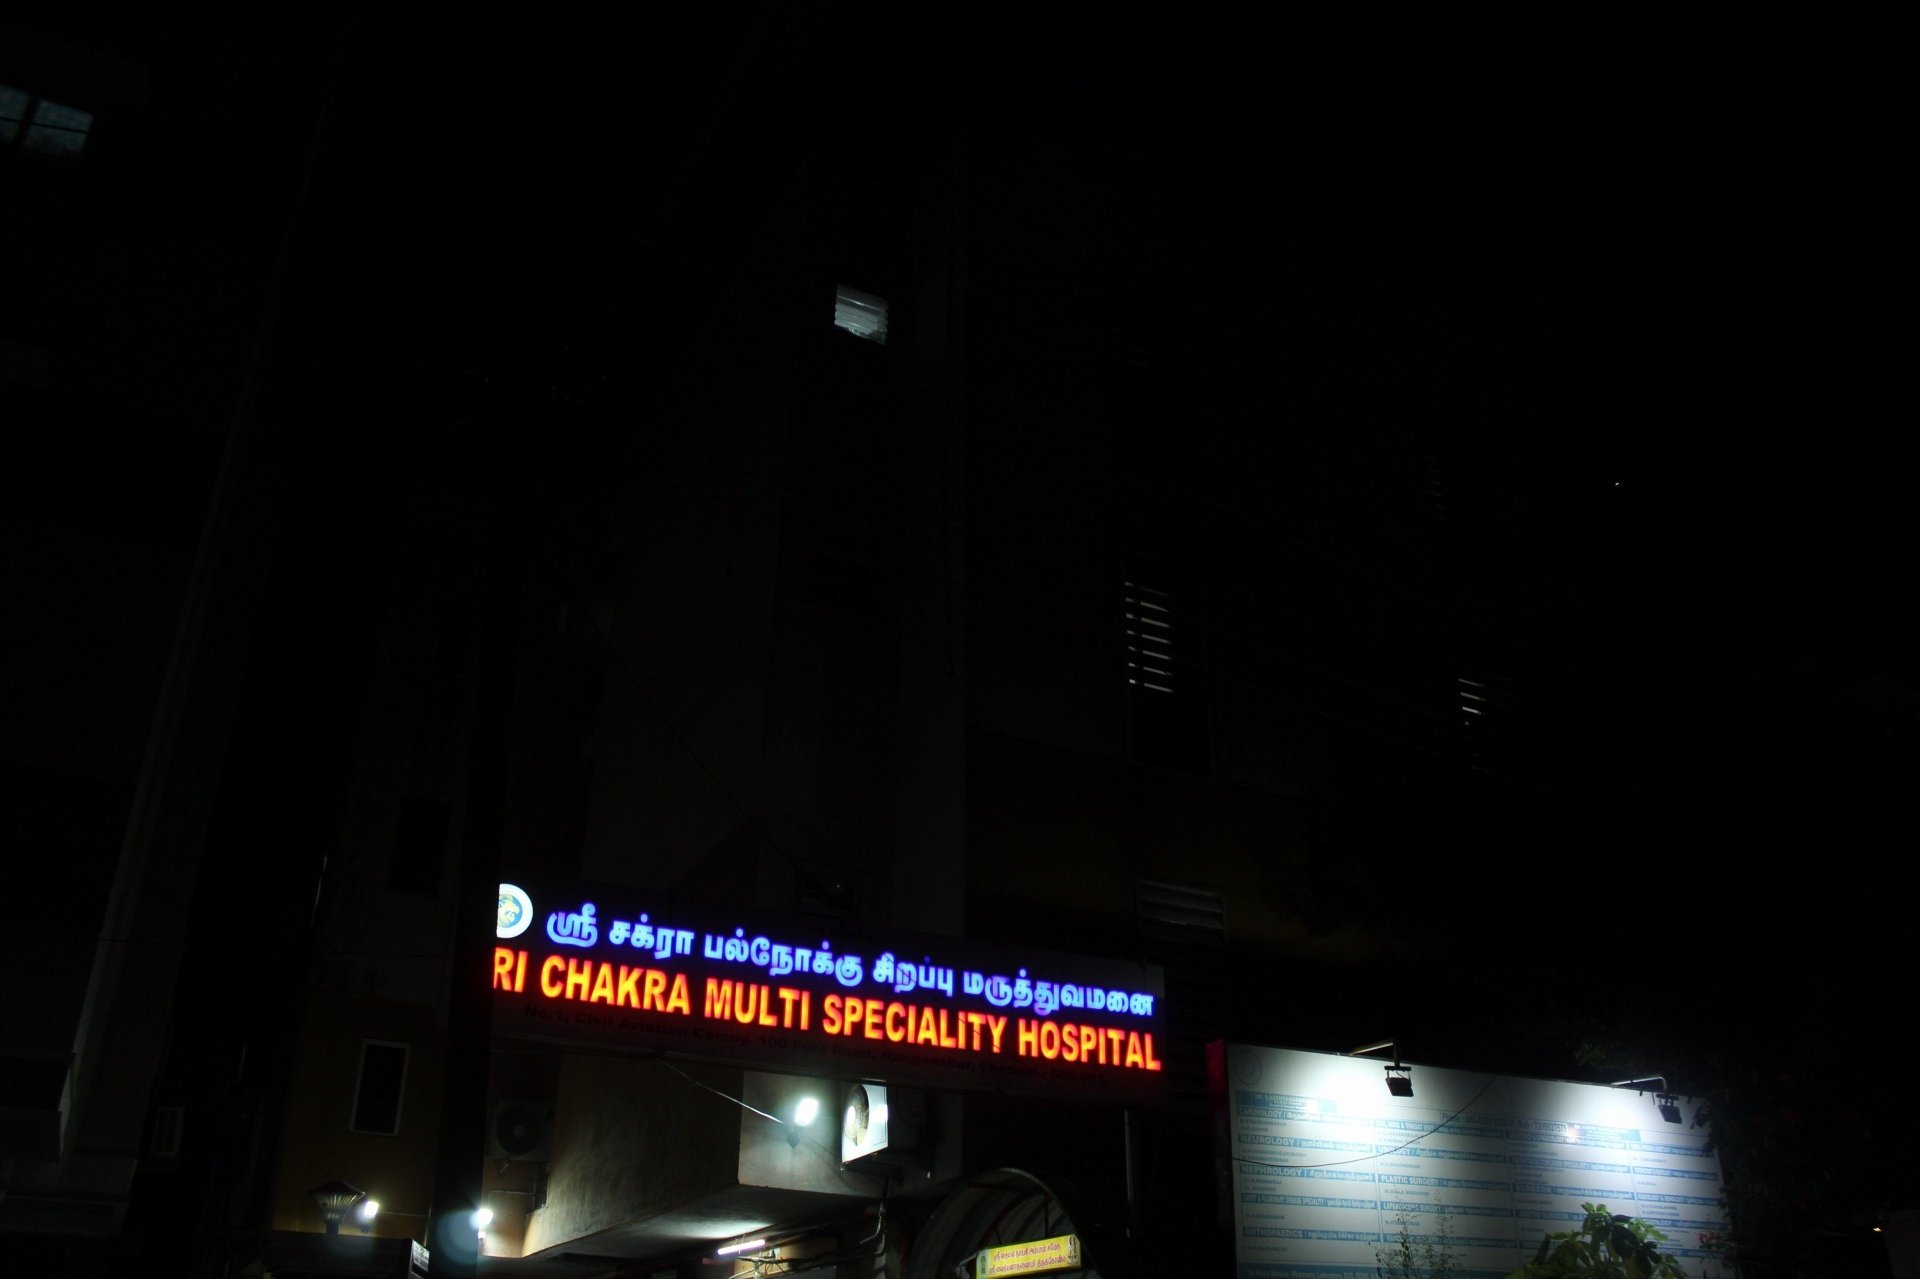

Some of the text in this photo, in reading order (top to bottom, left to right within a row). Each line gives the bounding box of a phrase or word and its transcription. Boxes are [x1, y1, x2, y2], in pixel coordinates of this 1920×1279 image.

[547, 902, 1154, 1016] ஸ்ரீ சக்ரா பல்நோக்கு சிறப்பு மருத்துவமனை
[540, 955, 691, 1016] CHAKRA
[703, 977, 811, 1031] MULTI
[822, 993, 1008, 1054] SPECIALITY
[1018, 1017, 1162, 1071] HOSPITAL
[1240, 1133, 1294, 1147] NEUROLOGY
[1241, 1165, 1302, 1178] NEPHROLOGY
[1380, 1175, 1408, 1185] PLASTIC
[1409, 1177, 1440, 1188] SURGERY
